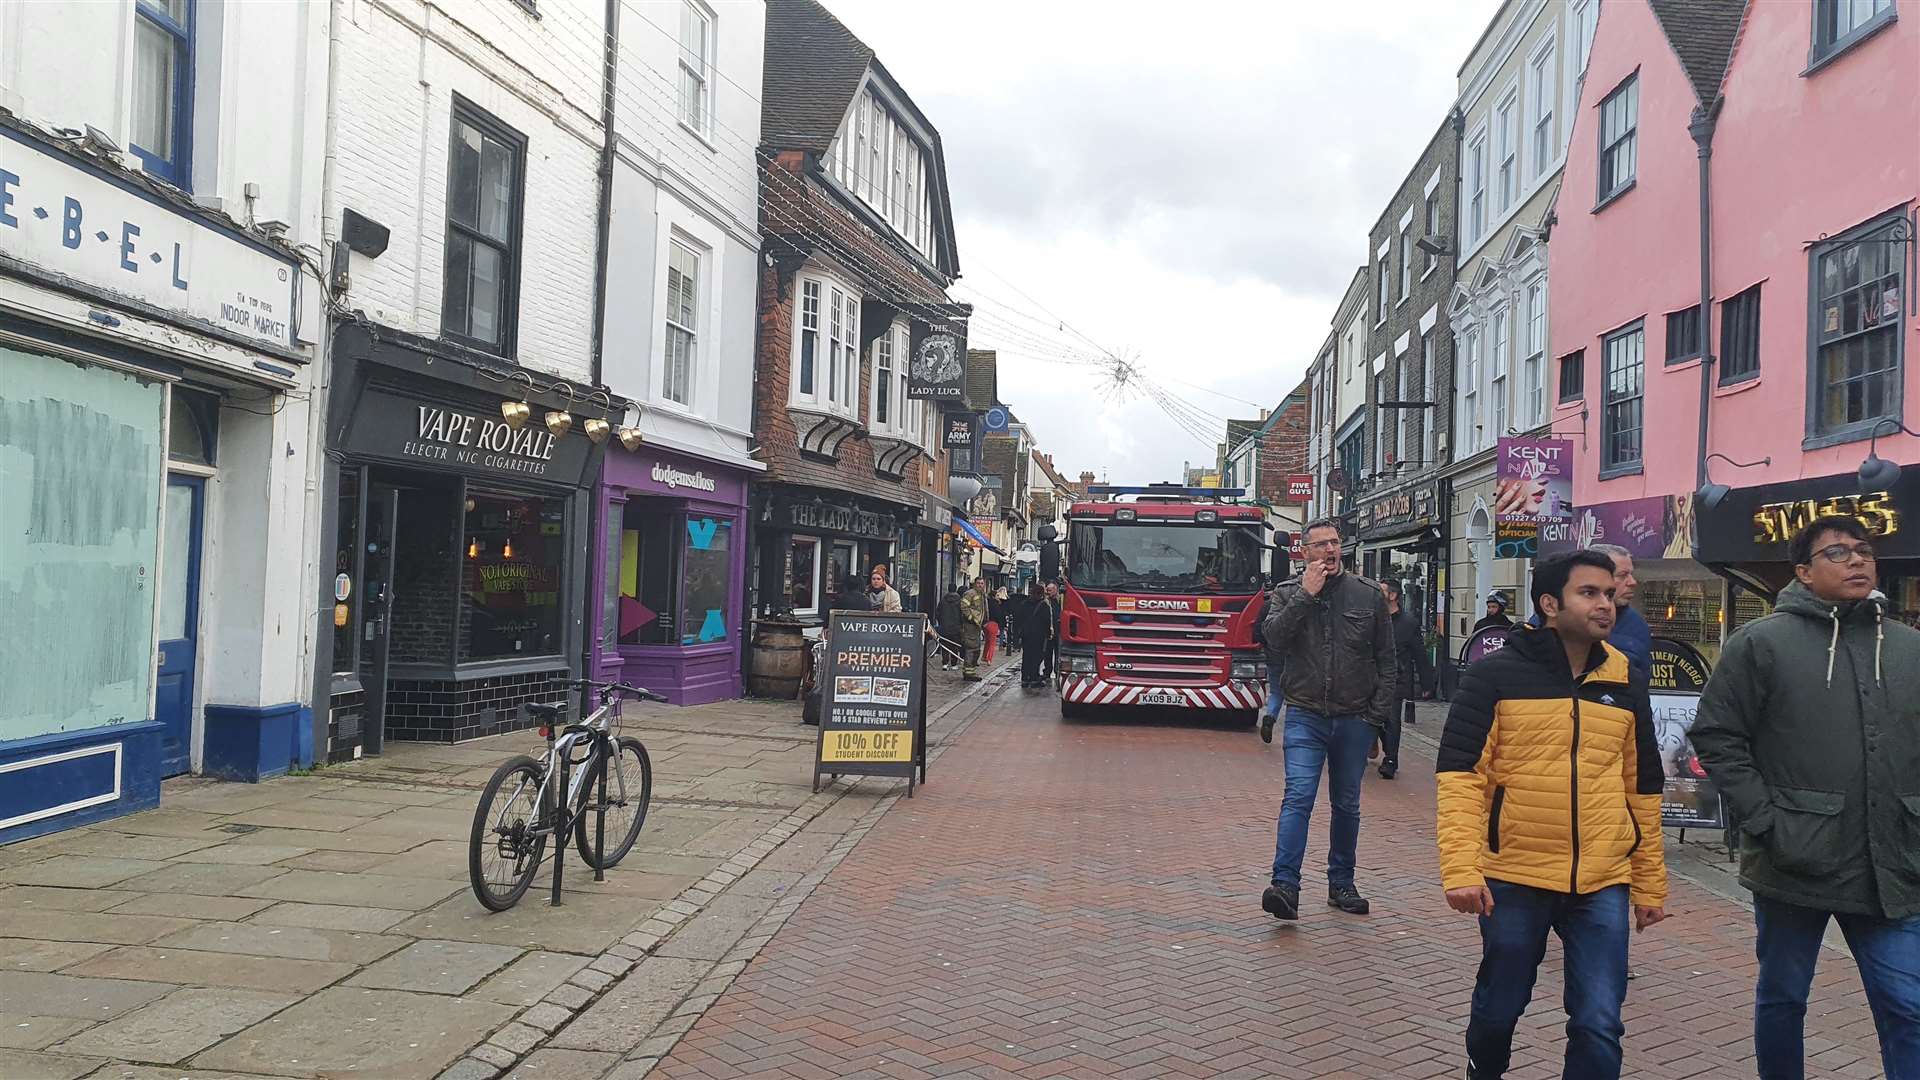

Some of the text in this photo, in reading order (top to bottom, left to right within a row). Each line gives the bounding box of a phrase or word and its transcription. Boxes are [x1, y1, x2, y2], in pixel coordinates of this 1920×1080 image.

[220, 303, 250, 328] INDOOR
[253, 314, 285, 339] MARKET
[929, 324, 949, 332] THE
[910, 387, 961, 395] LADY LUCK
[418, 406, 557, 460] VAPE ROYALE
[948, 432, 971, 440] ARMY
[403, 441, 546, 475] ELECTR NIC CIGARETTES
[1508, 446, 1562, 459] KENT
[790, 503, 880, 536] THE LADY LUCK
[1543, 523, 1569, 542] KENT
[1138, 600, 1190, 610] SCANIA
[840, 622, 914, 633] VAPE ROYALE
[1482, 637, 1506, 647] KEN
[837, 651, 912, 667] PREMIER
[1650, 651, 1704, 686] TMENT NEEDED
[1652, 664, 1675, 678] UST
[1668, 679, 1677, 687] IN
[1142, 694, 1183, 704] KX09 BJZ
[855, 709, 877, 717] GOOGLE
[893, 711, 908, 719] OVER
[1652, 707, 1698, 721] YLERS
[862, 717, 888, 725] REVIEWS
[837, 733, 899, 750] 10% OFF
[835, 750, 898, 759] STUDENT DISCOUNT
